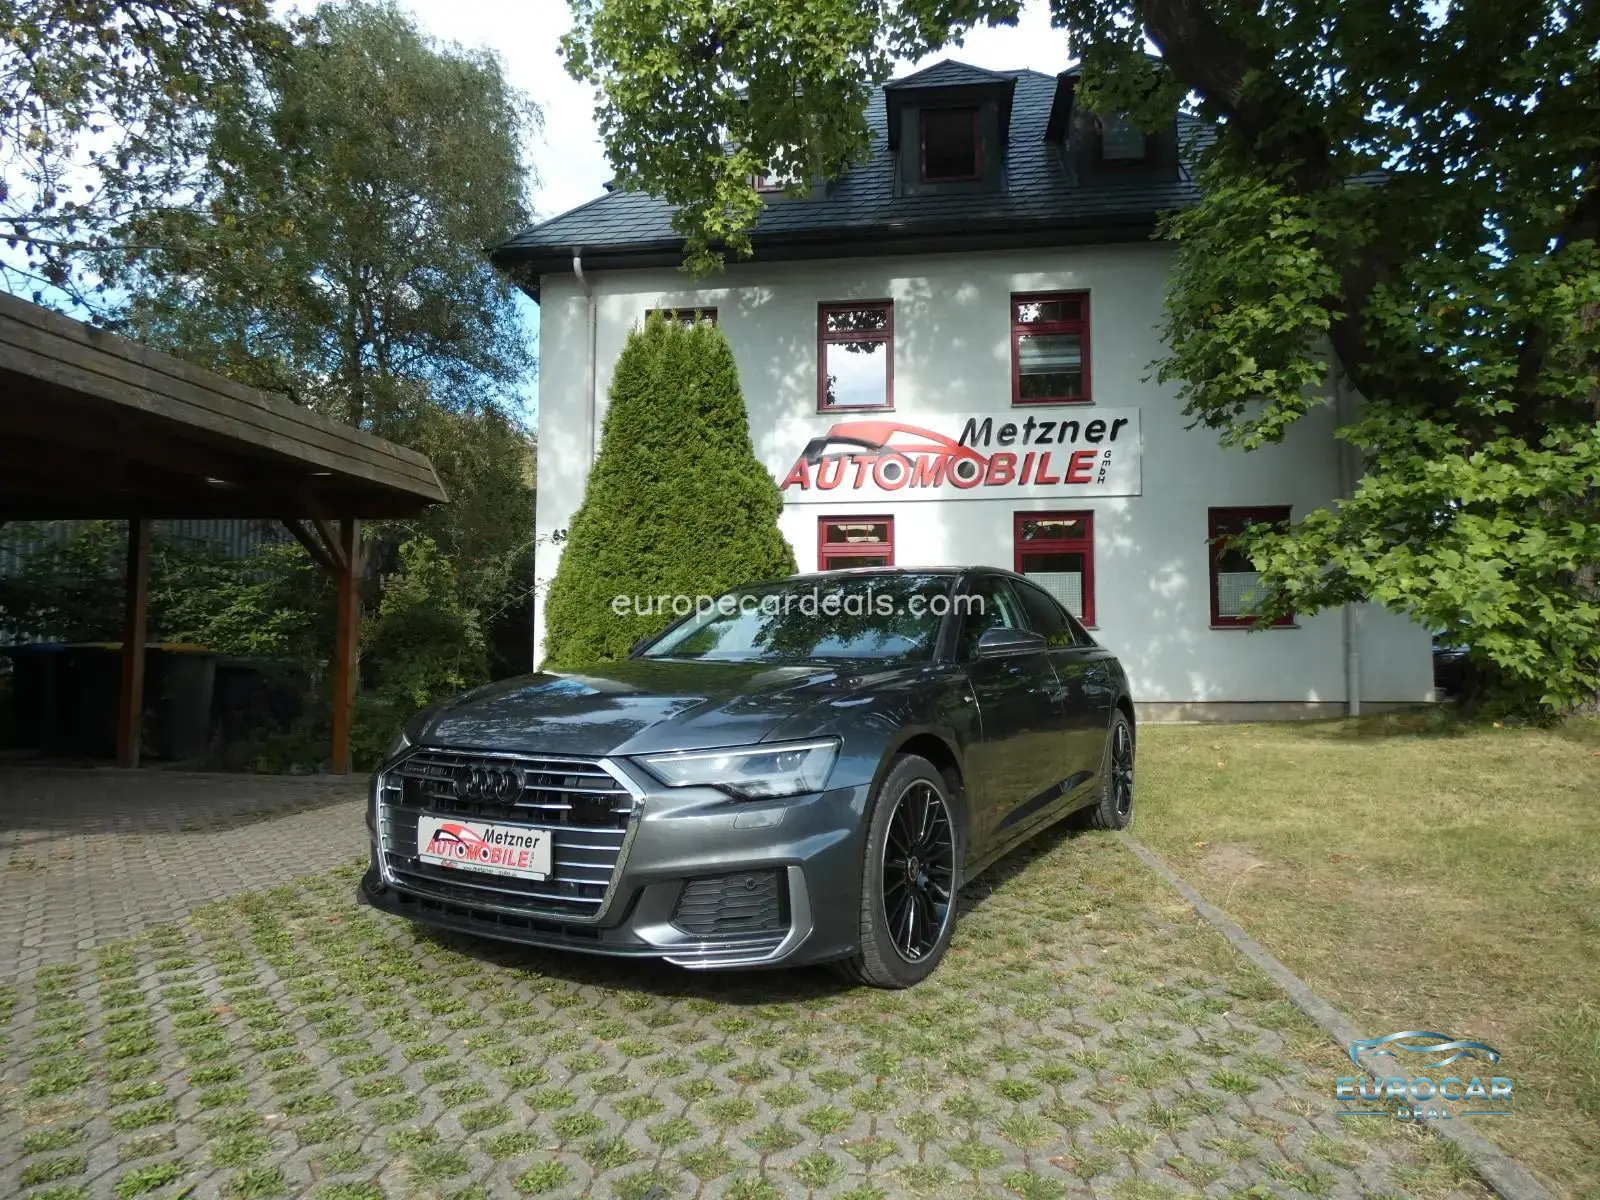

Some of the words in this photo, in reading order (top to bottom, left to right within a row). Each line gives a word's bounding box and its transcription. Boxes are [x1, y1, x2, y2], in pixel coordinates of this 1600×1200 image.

[958, 416, 1129, 448] Metzner
[780, 449, 1098, 491] AUTOMOBILE
[1097, 450, 1111, 485] GmbH
[426, 840, 530, 868] AUTOMOBILE
[482, 828, 541, 849] Metzner
